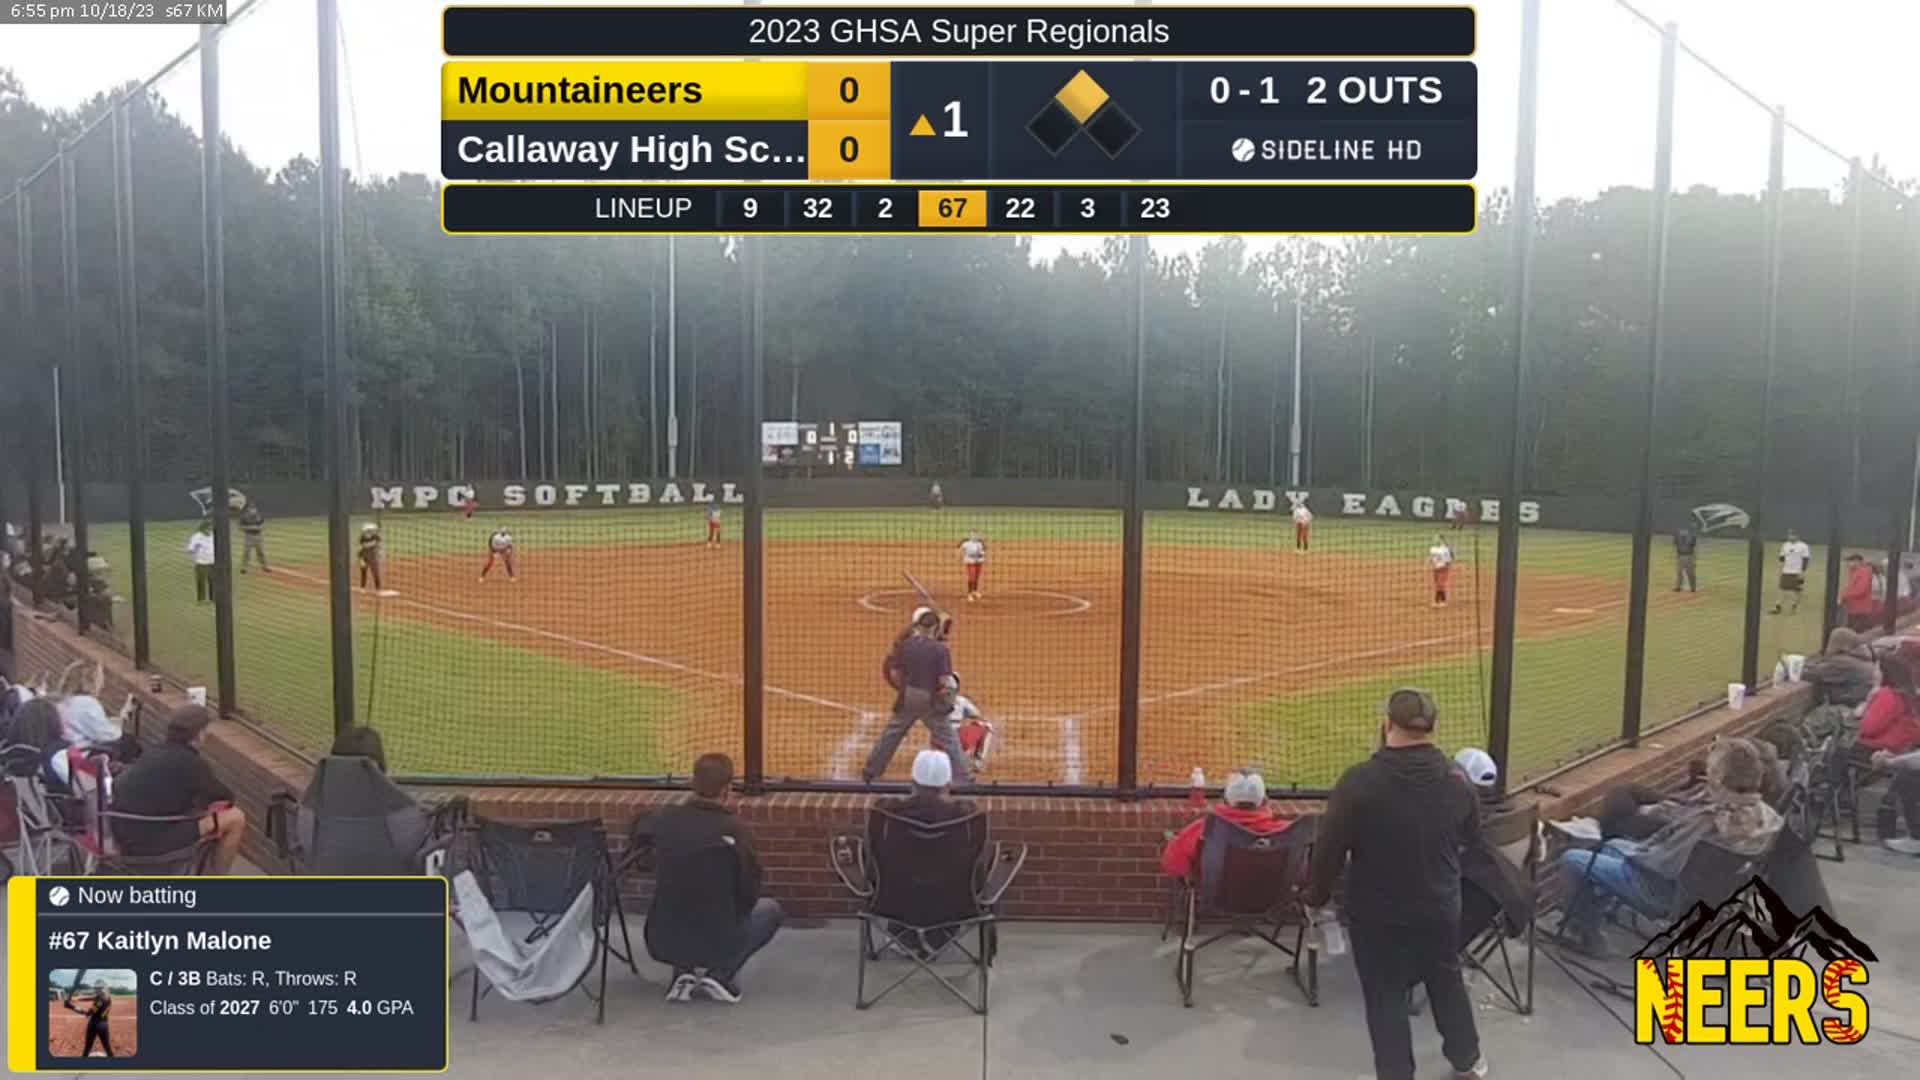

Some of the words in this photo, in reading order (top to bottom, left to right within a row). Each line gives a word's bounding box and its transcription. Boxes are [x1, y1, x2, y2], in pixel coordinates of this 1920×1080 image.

[370, 485, 476, 509] MPC
[504, 482, 744, 507] SOFTBALL
[1187, 487, 1311, 512] LADY
